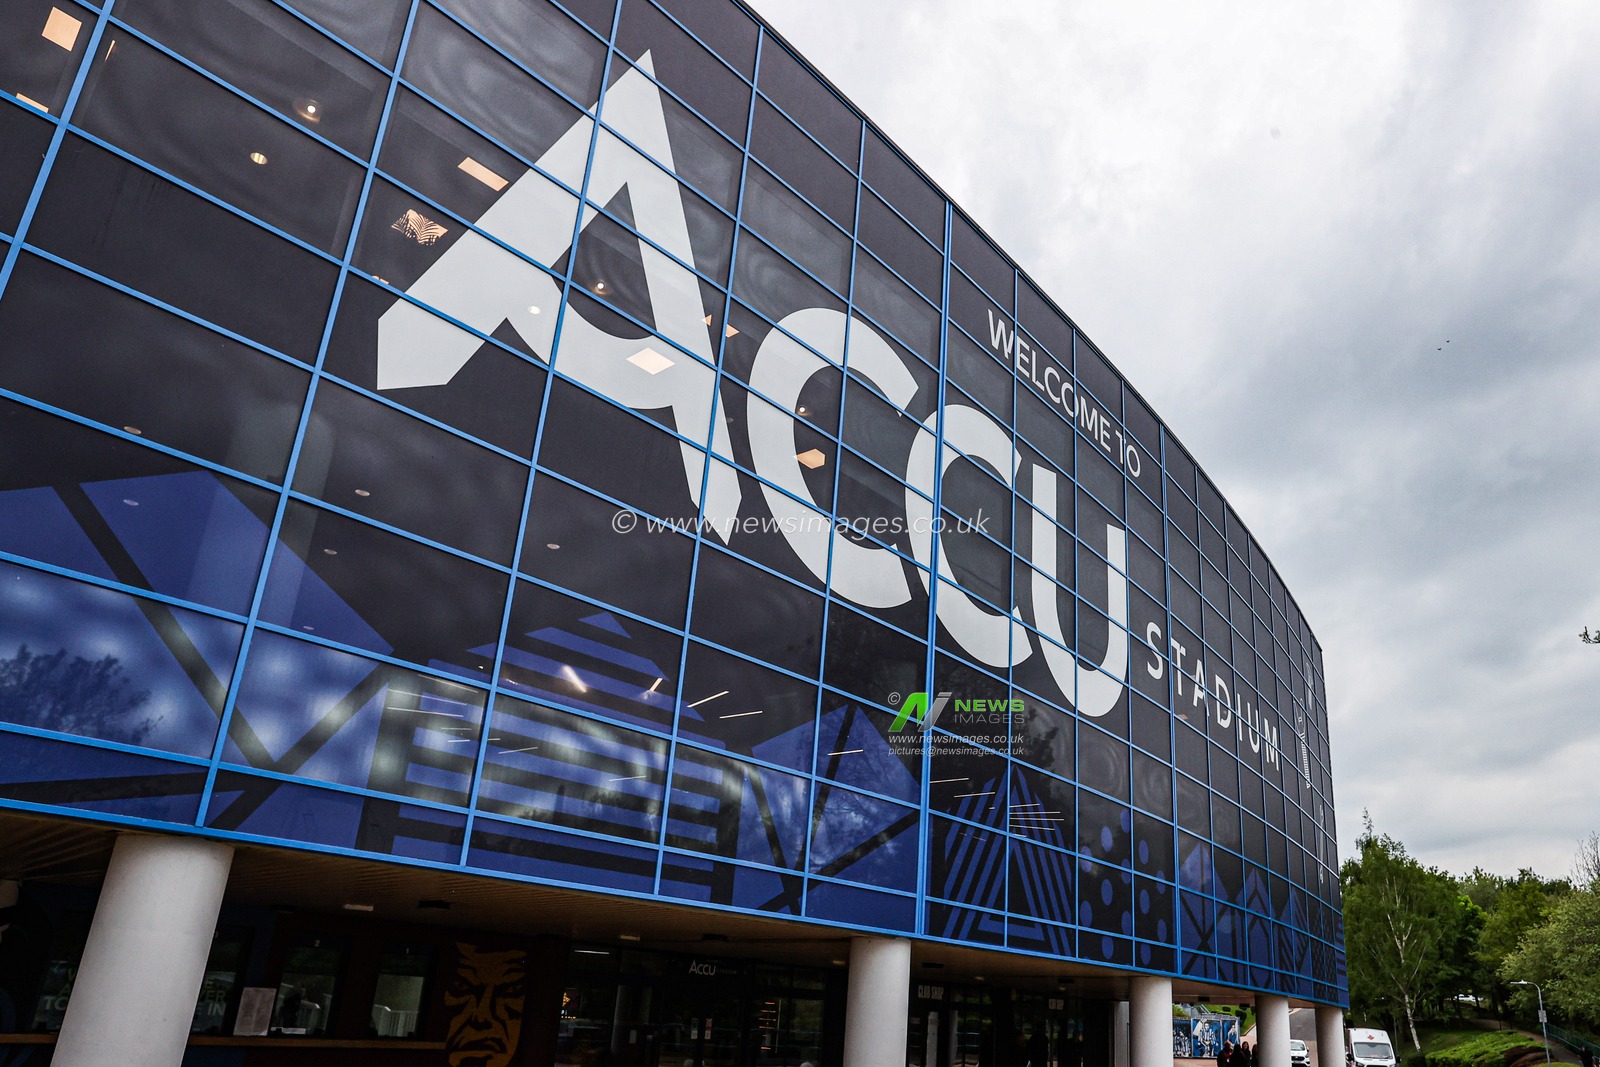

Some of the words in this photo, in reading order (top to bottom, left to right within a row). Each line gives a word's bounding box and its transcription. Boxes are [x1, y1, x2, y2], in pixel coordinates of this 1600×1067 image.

[376, 49, 1129, 717] ACCU
[988, 309, 1111, 453] WELCOME
[1116, 430, 1141, 477] TO
[1146, 621, 1280, 772] STADIUM
